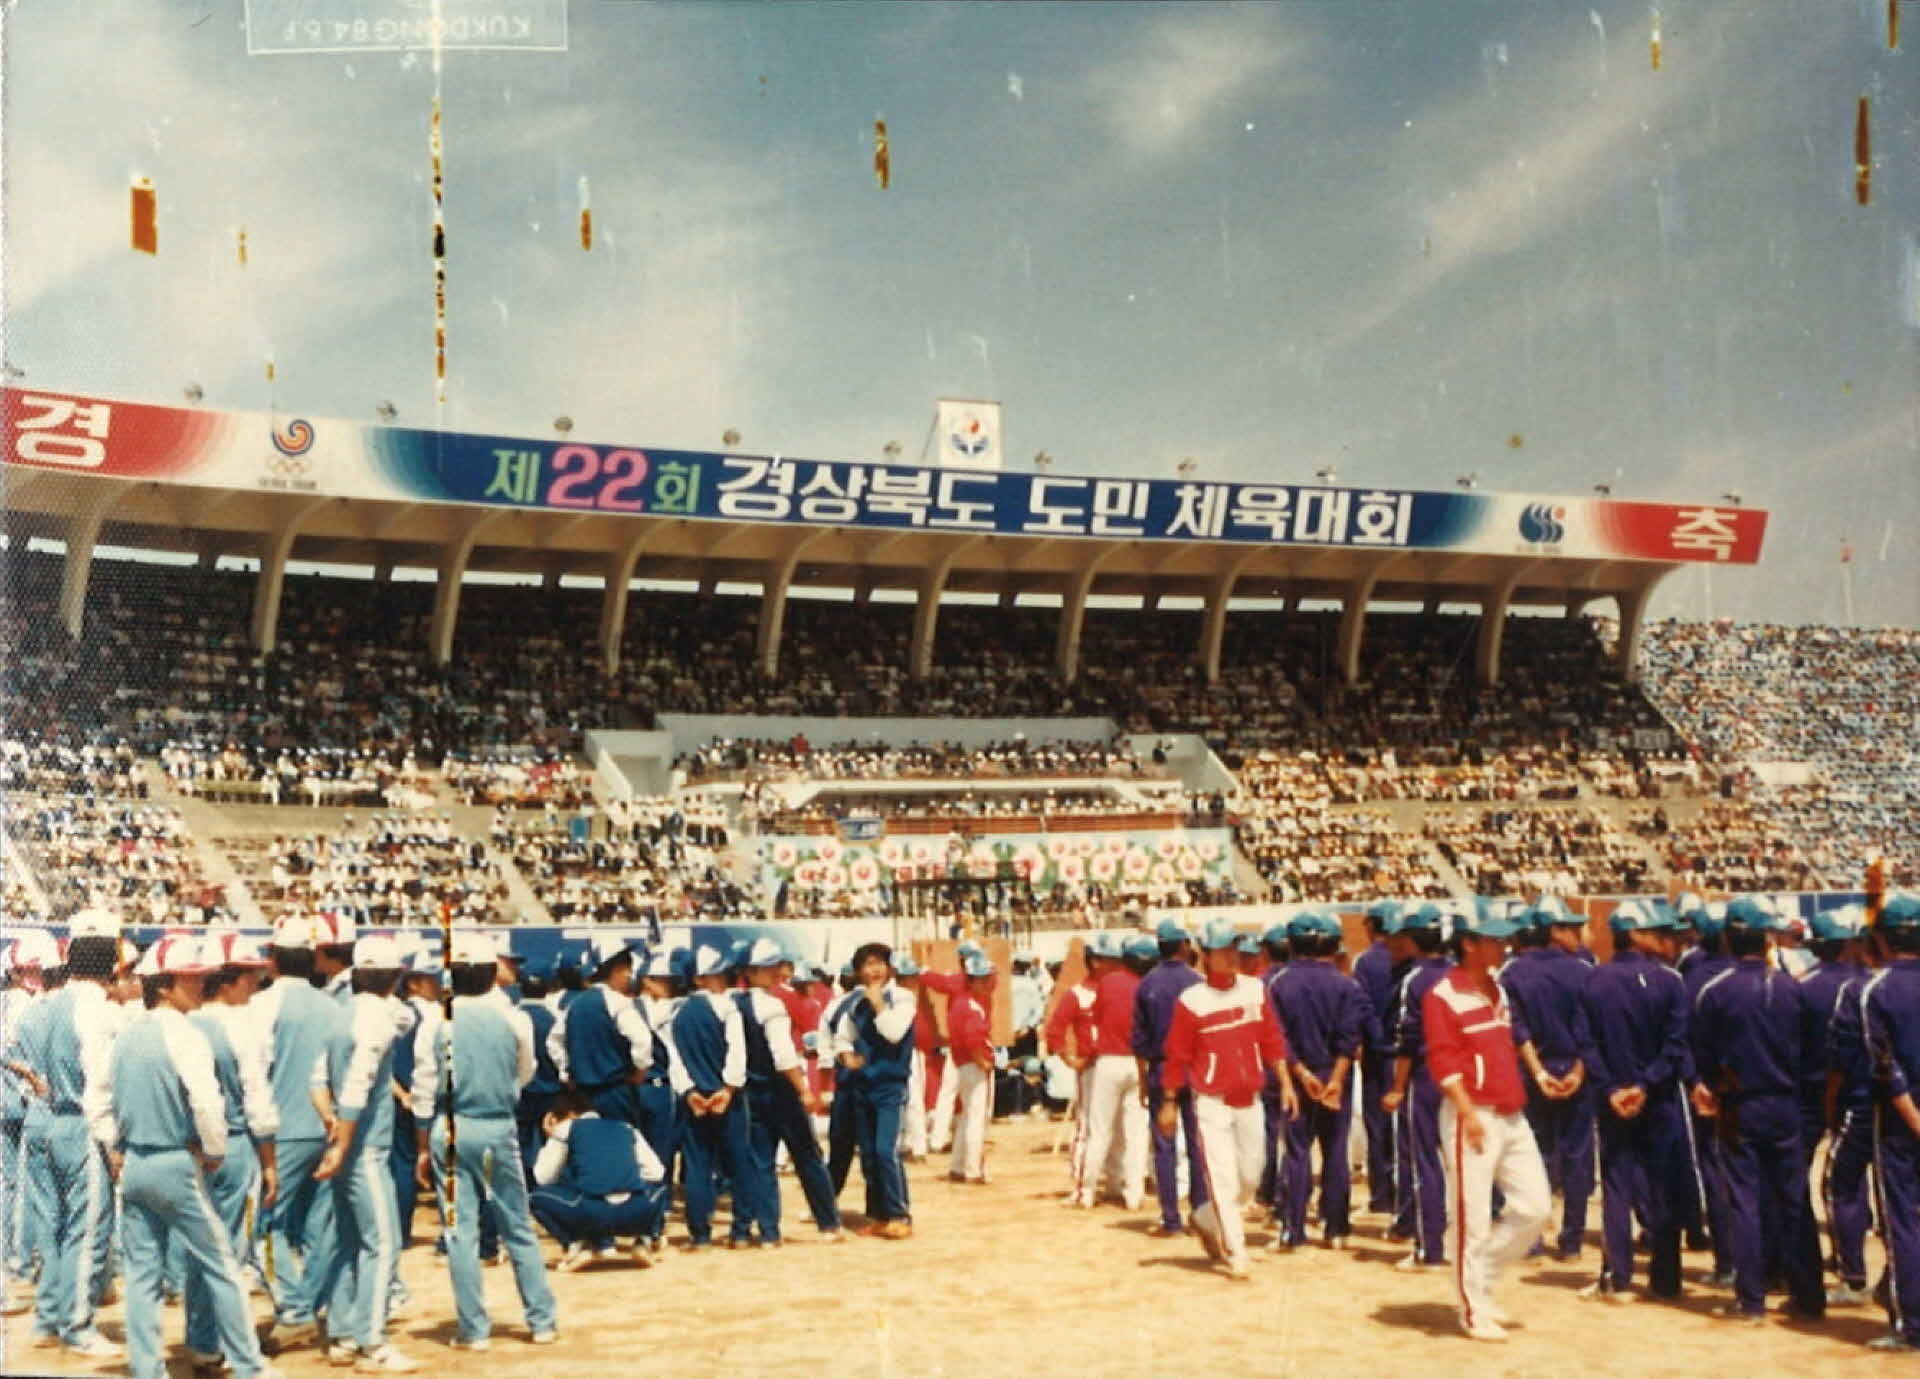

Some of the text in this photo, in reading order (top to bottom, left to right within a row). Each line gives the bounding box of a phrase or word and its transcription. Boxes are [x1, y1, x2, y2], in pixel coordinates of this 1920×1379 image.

[15, 395, 111, 468] 경
[716, 456, 998, 529] 경상북도
[1022, 476, 1150, 536] 도민
[1166, 485, 1414, 546] 체육대회
[1671, 509, 1738, 560] 축
